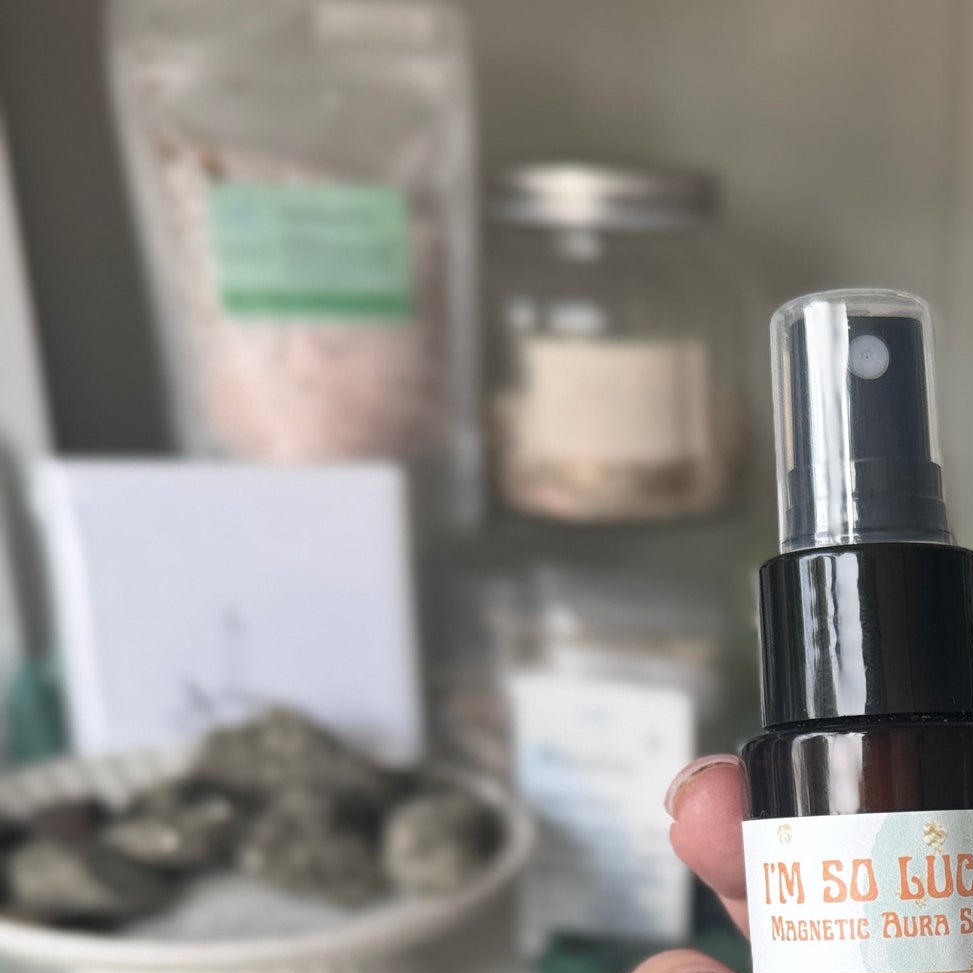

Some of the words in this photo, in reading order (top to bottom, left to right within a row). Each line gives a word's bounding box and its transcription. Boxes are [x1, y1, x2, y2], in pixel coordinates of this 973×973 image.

[763, 862, 805, 904] I'M
[822, 858, 879, 903] SO
[771, 915, 870, 941] MAGNETIC
[881, 911, 950, 939] AURA
